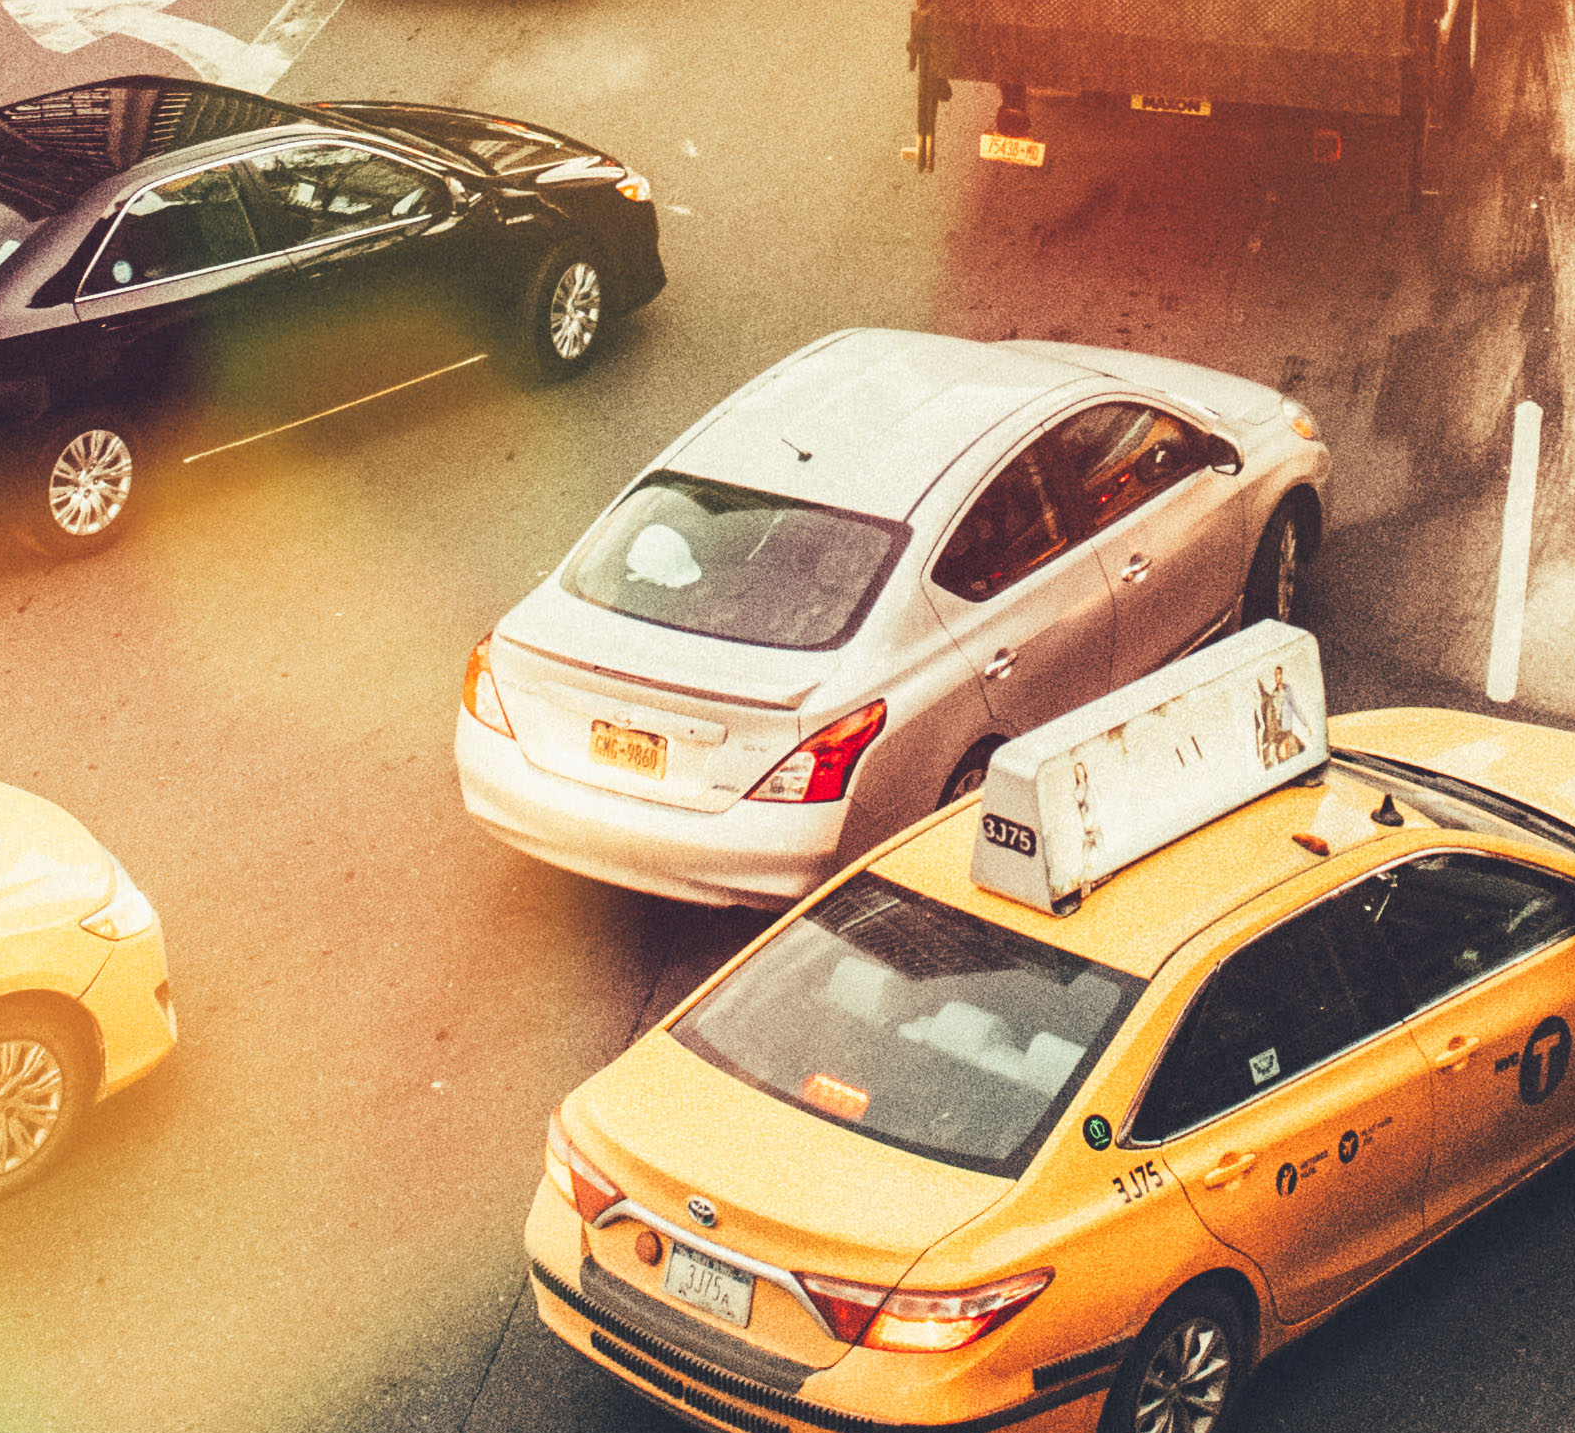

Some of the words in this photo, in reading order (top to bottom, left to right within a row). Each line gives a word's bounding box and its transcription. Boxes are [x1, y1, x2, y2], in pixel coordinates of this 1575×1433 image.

[1142, 95, 1201, 113] MAXON
[985, 817, 1031, 852] 3J75
[1532, 1030, 1562, 1094] T
[1112, 1160, 1164, 1204] 3J75
